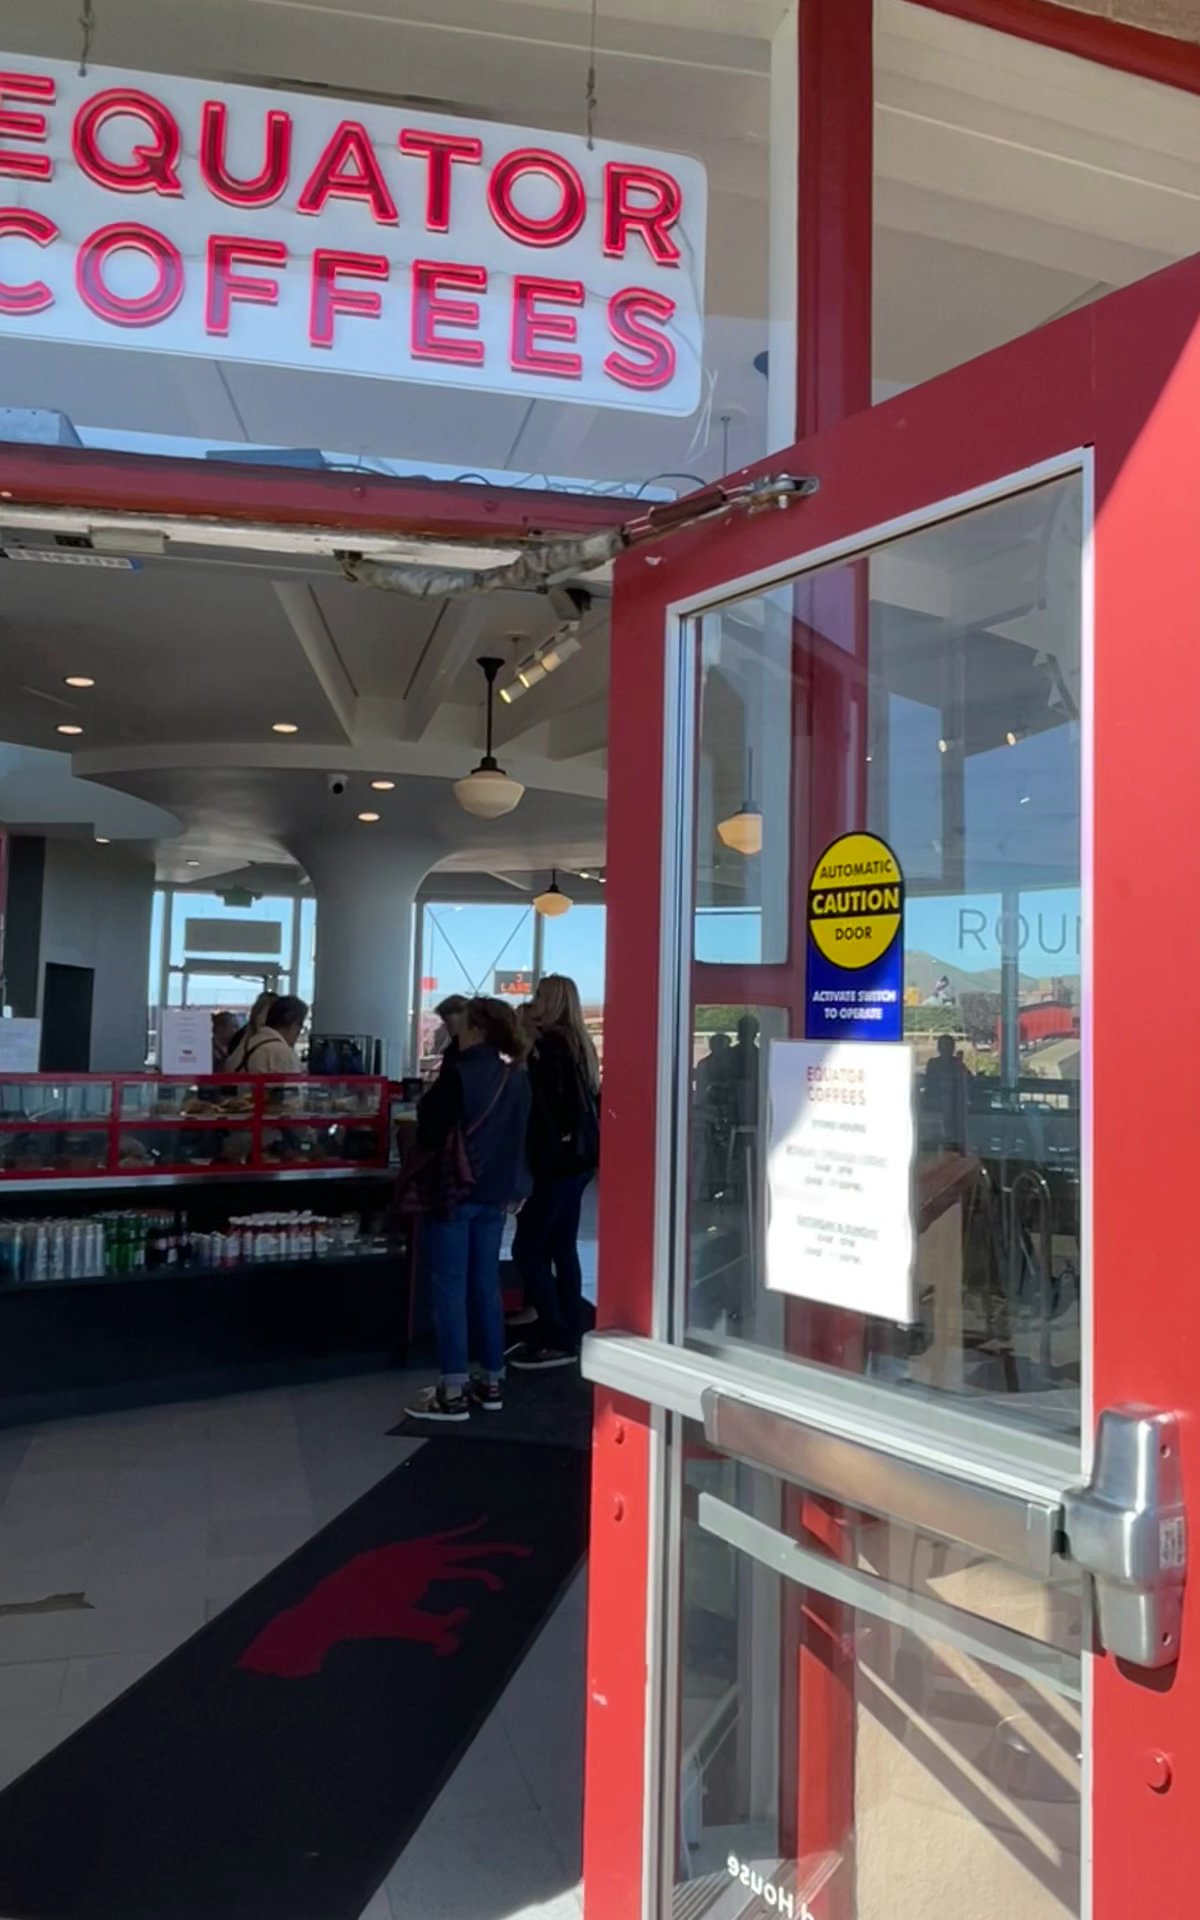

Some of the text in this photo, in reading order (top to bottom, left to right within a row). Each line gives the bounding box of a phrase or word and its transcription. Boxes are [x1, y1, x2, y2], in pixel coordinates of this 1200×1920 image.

[0, 71, 683, 267] EQUATOR
[0, 206, 677, 391] COFFEES
[820, 858, 893, 879] AUTOMATIC
[812, 887, 900, 914] CAUTION
[835, 926, 872, 941] DOOR
[812, 989, 897, 1003] ACTIVATE SWITCH
[824, 1008, 883, 1020] TO OPERATE
[807, 1066, 864, 1083] EQUATOR
[808, 1087, 866, 1105] COFFEES
